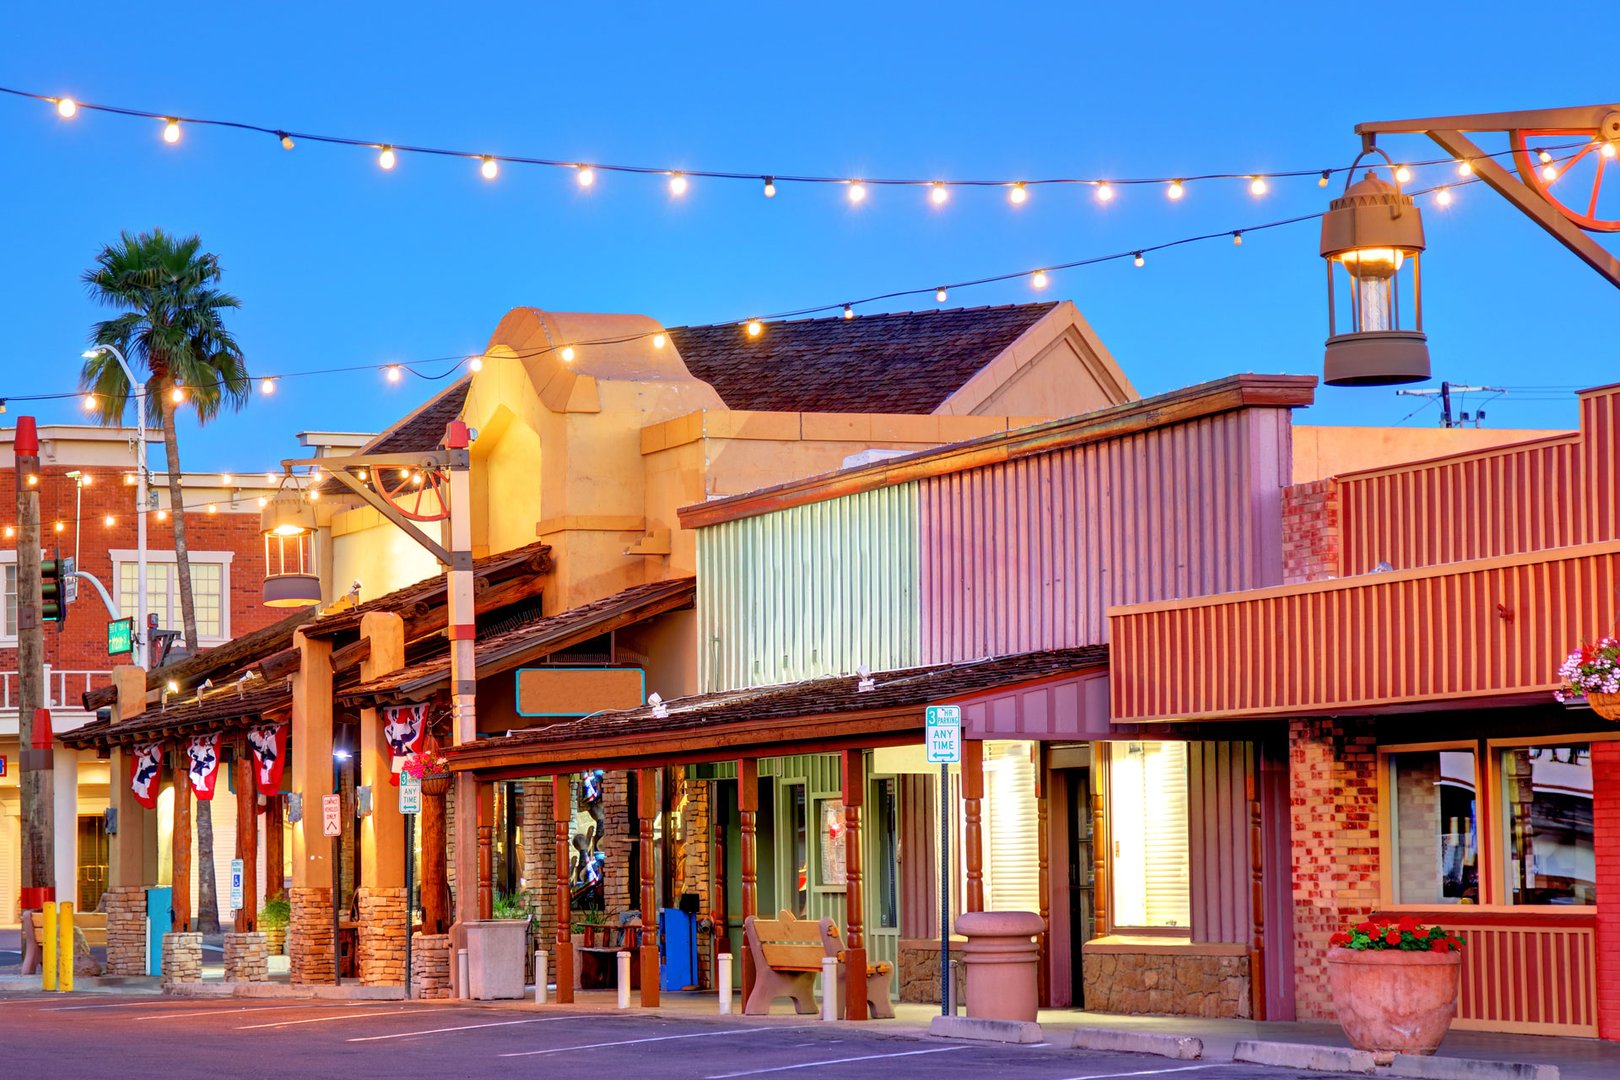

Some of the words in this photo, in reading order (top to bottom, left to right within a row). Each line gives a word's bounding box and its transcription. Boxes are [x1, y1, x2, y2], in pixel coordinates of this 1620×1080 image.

[928, 710, 936, 724] 3
[934, 730, 953, 738] ANY
[933, 741, 954, 750] TIME
[401, 773, 407, 785] 3
